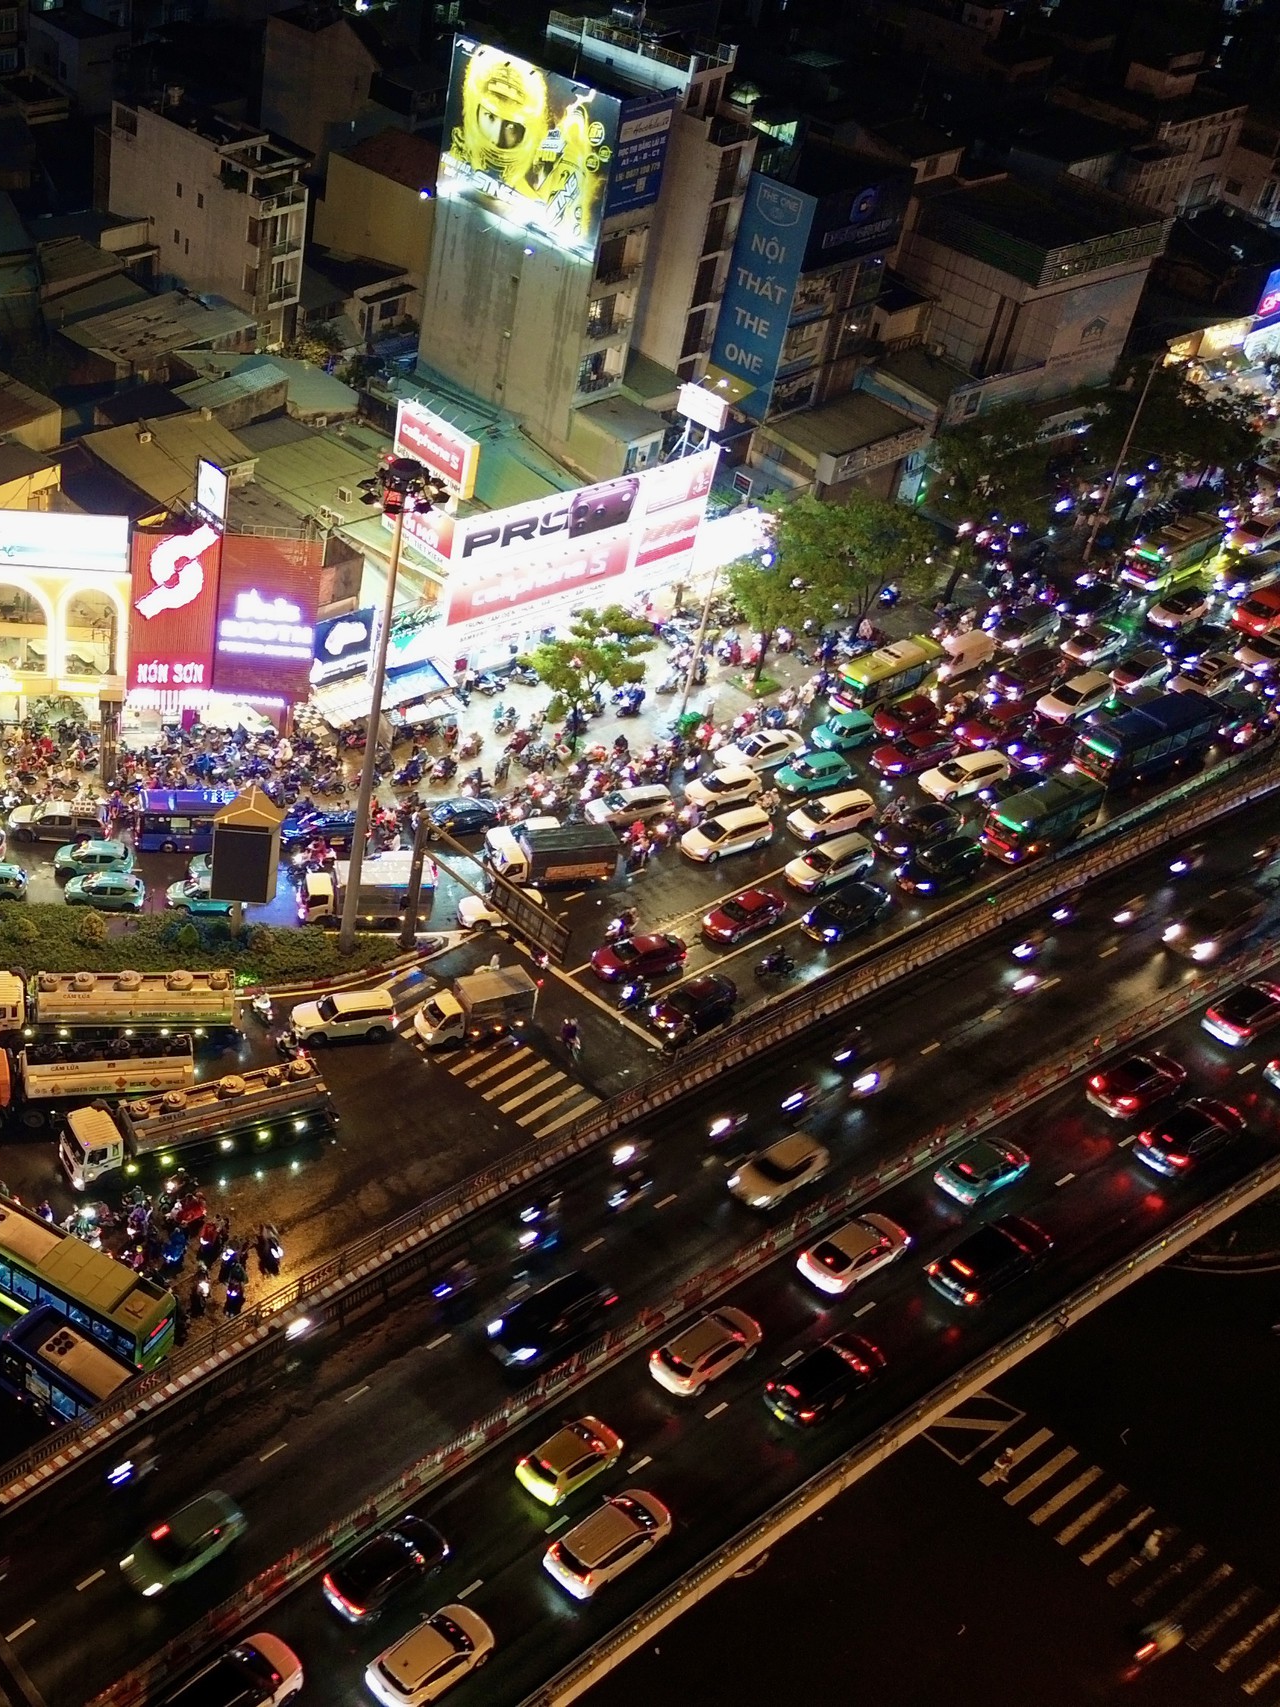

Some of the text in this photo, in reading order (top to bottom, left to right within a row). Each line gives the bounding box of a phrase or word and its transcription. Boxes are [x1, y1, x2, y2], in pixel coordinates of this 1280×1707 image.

[761, 188, 800, 213] THE ONE
[751, 233, 786, 264] NỘI
[737, 267, 787, 305] THẤT
[735, 306, 770, 339] THE
[724, 343, 763, 375] ONE
[402, 423, 459, 471] cellphoneS
[472, 553, 609, 607] cellphoneS
[137, 660, 204, 684] NÓN SƠN
